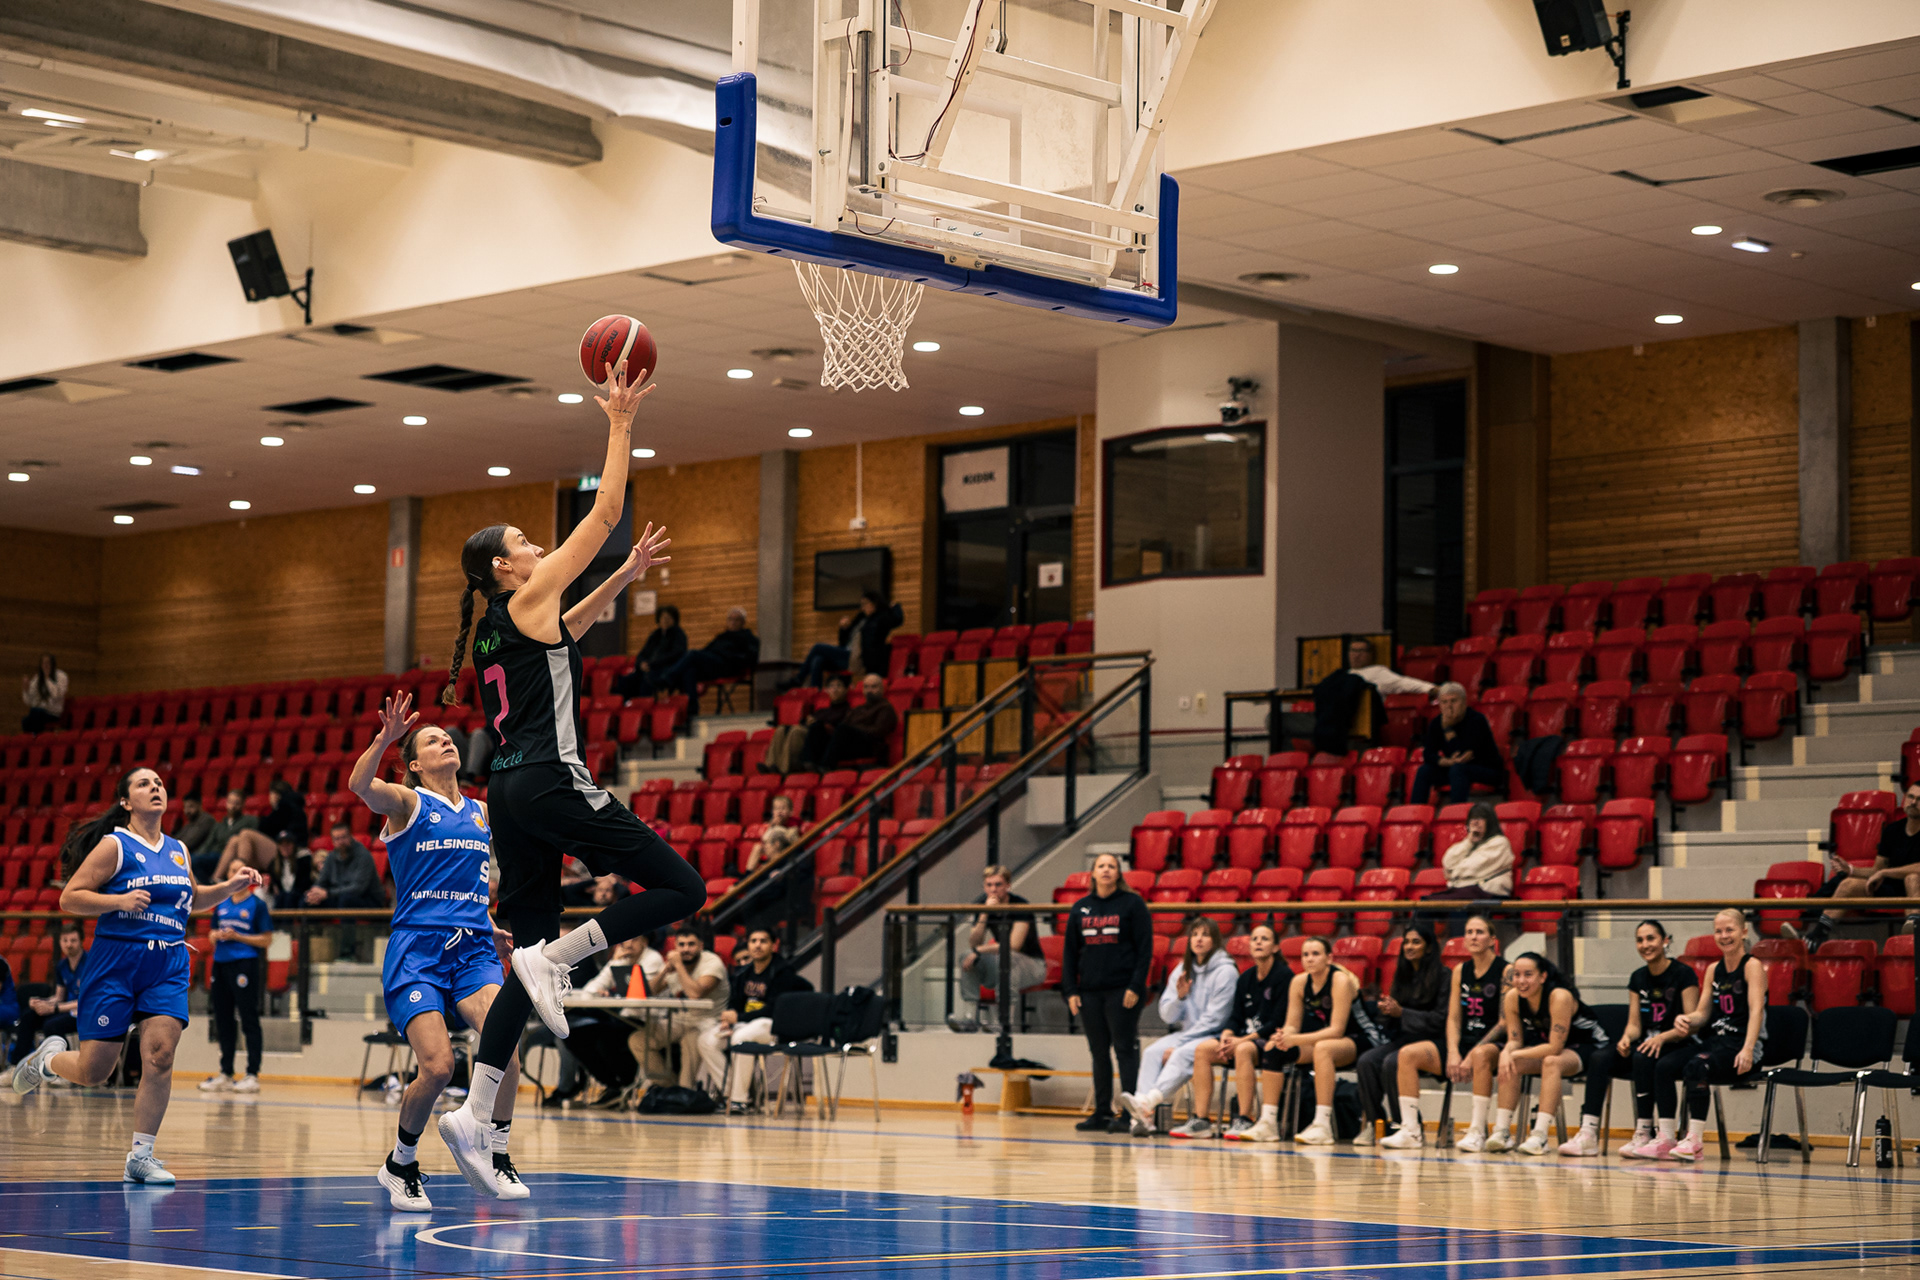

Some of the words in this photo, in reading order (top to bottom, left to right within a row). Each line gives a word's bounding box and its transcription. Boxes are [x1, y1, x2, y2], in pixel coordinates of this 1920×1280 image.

[600, 330, 619, 363] molten
[483, 663, 510, 746] 7
[411, 890, 449, 900] NATHALIE
[450, 891, 473, 901] FRUKT
[1466, 997, 1484, 1016] 35
[1719, 994, 1734, 1014] 10
